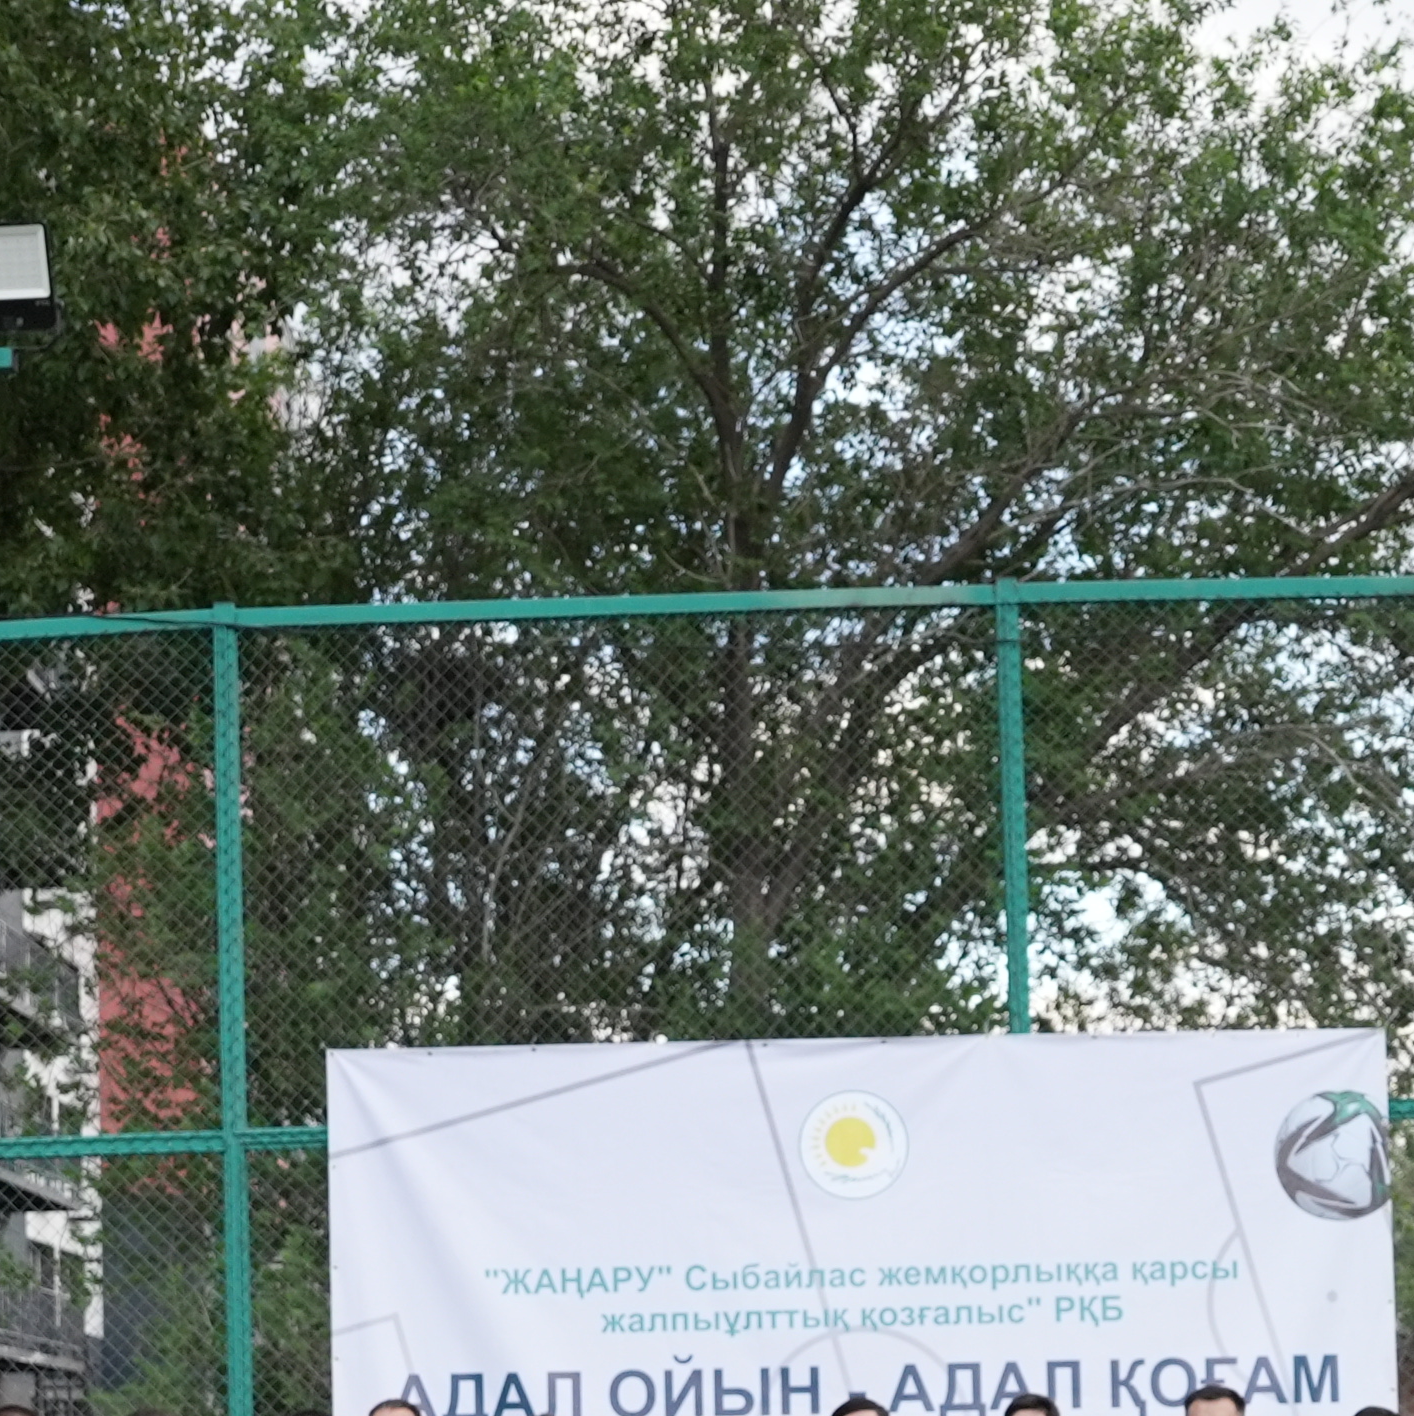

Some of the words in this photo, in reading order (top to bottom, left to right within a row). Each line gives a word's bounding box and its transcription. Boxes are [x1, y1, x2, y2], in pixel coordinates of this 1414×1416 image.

[685, 1262, 867, 1291] Сыбайлас
[877, 1259, 1120, 1290] жемқорлыққа
[1131, 1258, 1238, 1288] қарсы
[601, 1306, 851, 1337] жалпыұлттық
[861, 1296, 1041, 1332] қозғалыс"
[1055, 1294, 1124, 1327] РҚБ
